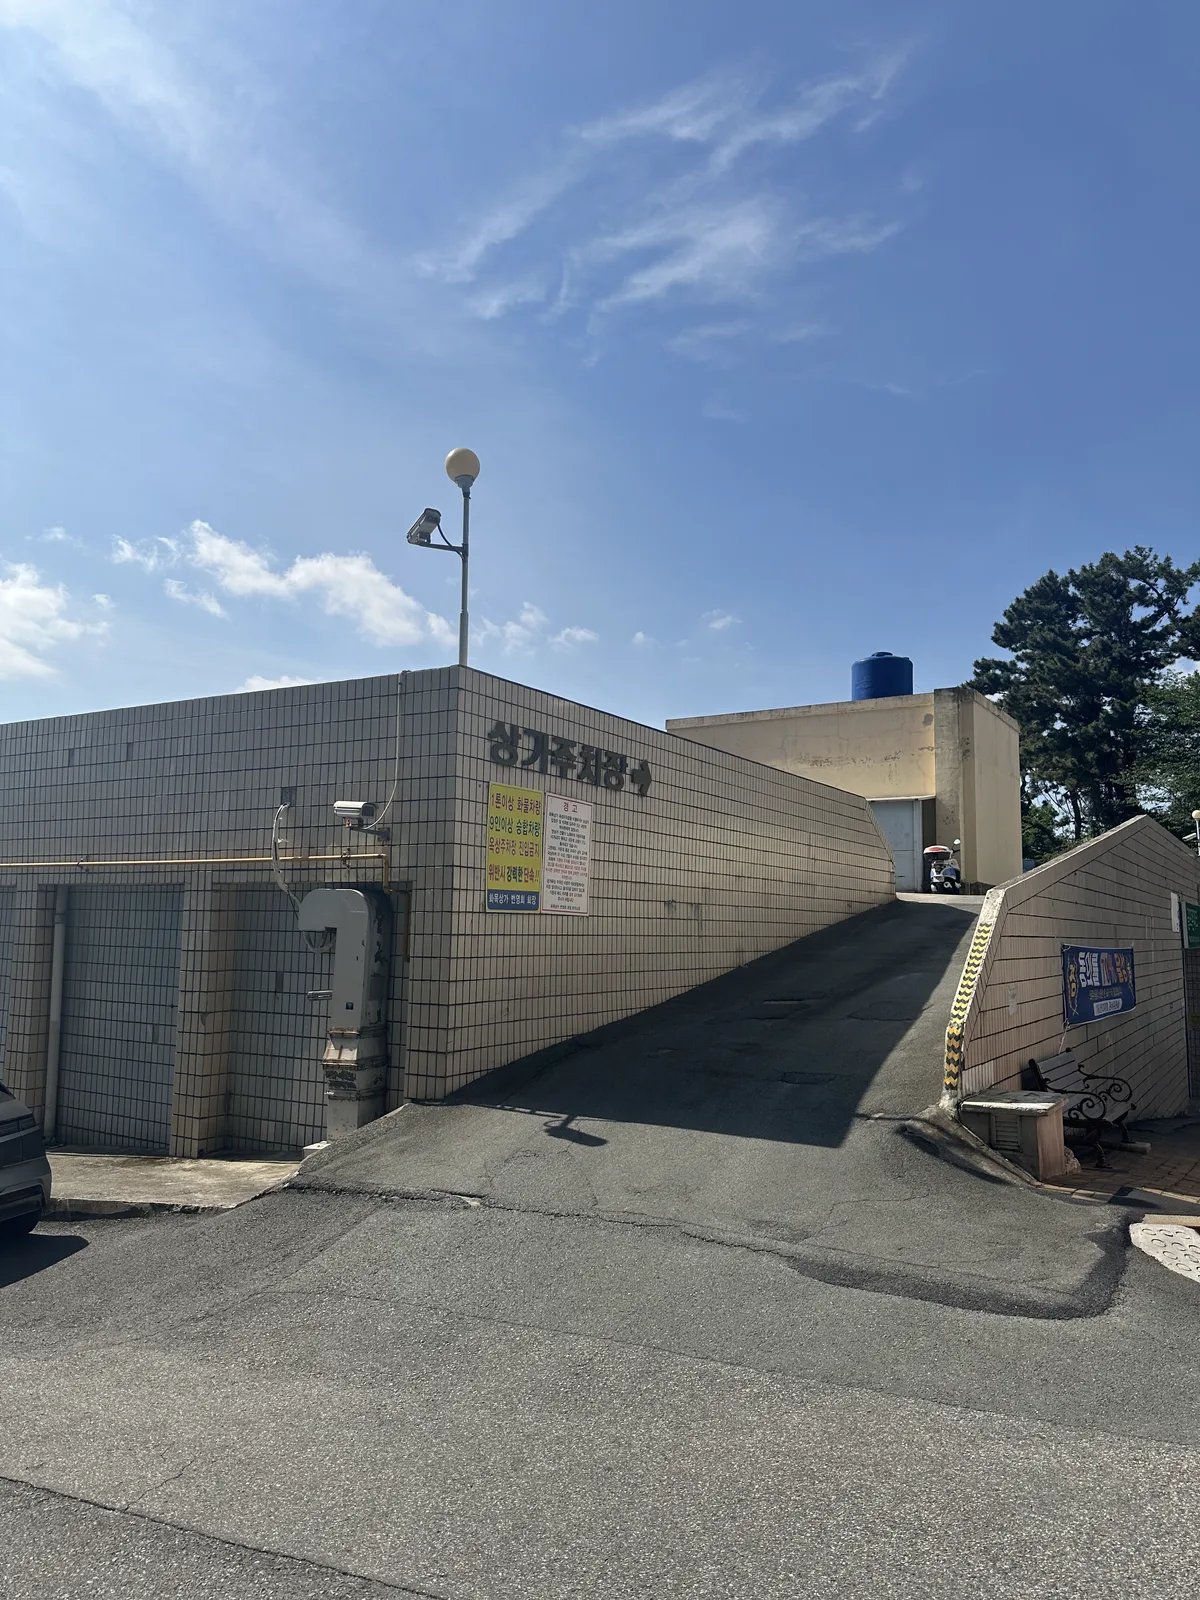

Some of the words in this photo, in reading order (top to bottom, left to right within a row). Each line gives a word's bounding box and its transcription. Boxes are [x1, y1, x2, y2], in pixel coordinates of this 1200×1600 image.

[488, 720, 628, 791] 상가주차장
[491, 793, 514, 811] 1톤이상
[517, 796, 541, 815] 화물차량
[489, 816, 513, 834] 9인이상
[516, 819, 541, 837] 승합차량
[489, 837, 517, 855] 옥상주차장
[519, 841, 540, 857] 진입금지
[488, 864, 506, 882] 위반시
[506, 865, 523, 882] 강력한
[489, 893, 509, 904] 화목상가
[527, 895, 537, 905] 회장
